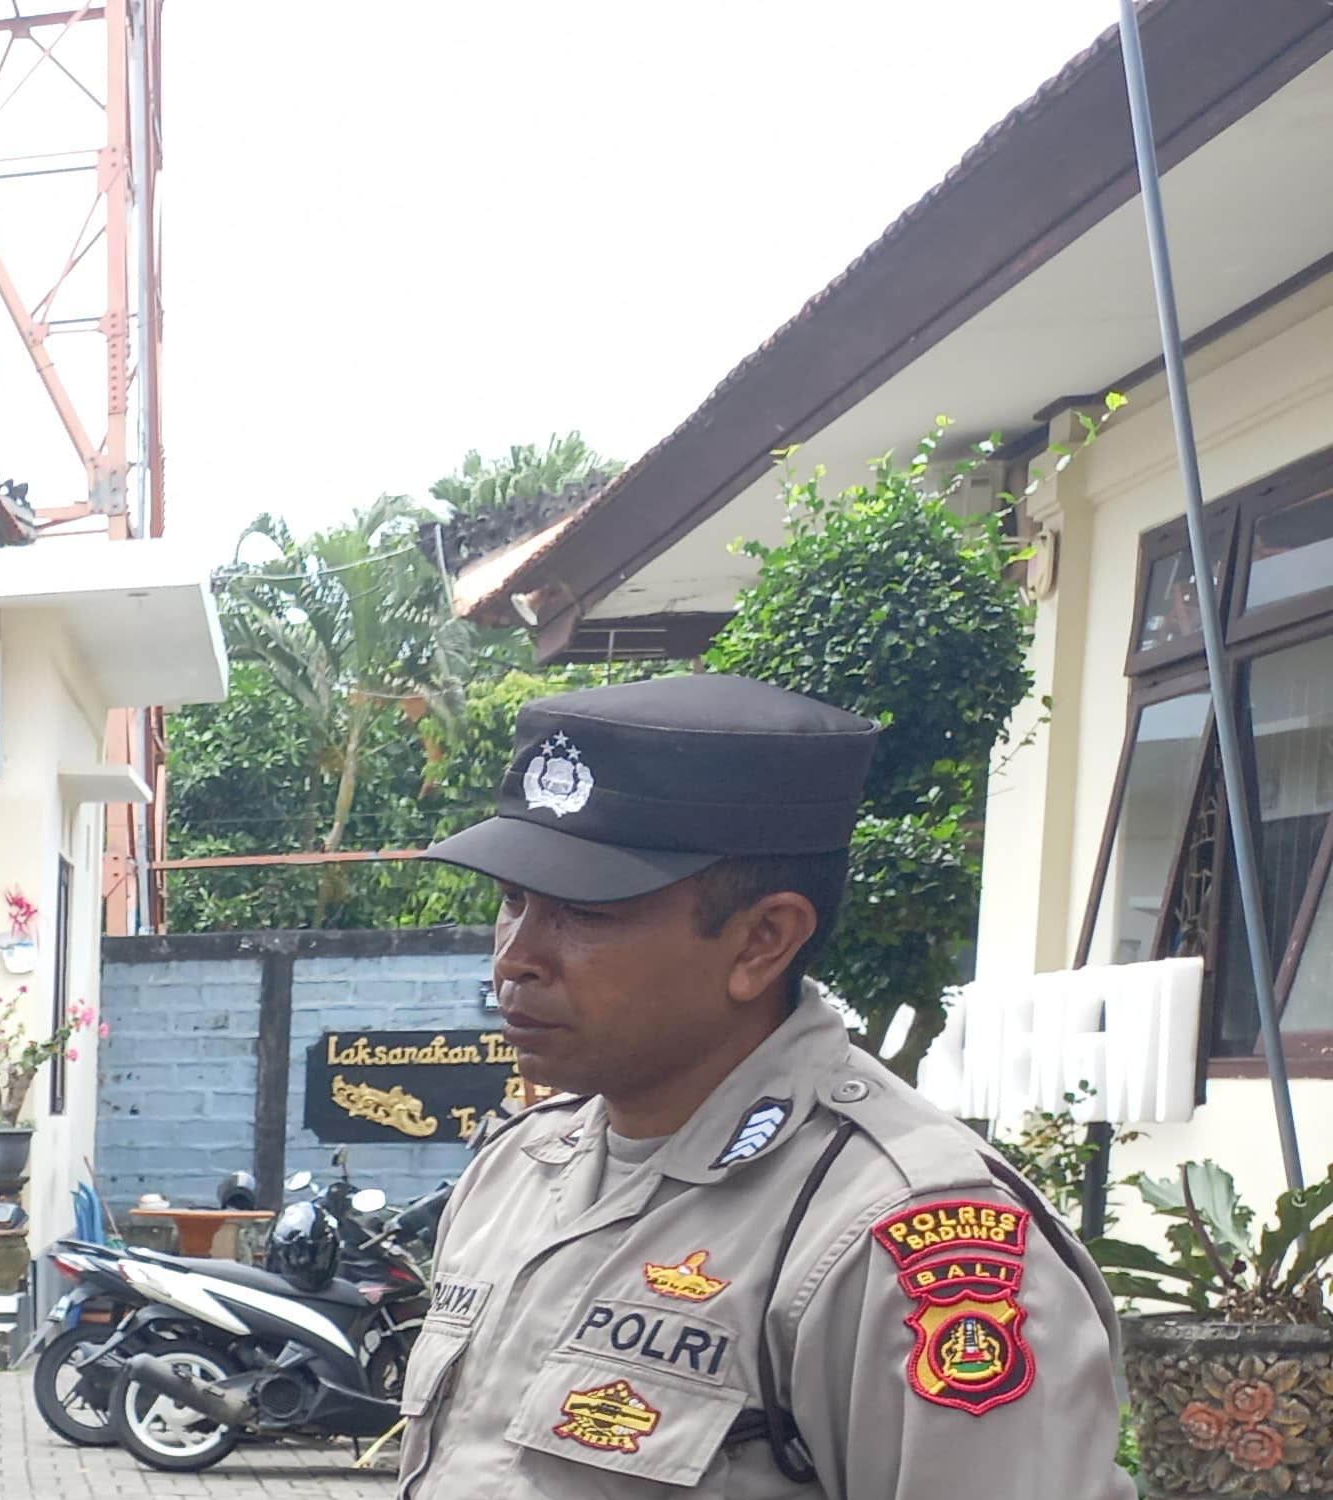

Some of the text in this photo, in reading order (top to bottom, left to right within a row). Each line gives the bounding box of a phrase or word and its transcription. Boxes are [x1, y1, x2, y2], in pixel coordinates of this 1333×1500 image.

[327, 1034, 483, 1067] Laksanakan
[888, 1206, 1016, 1242] POLRES
[907, 1227, 1006, 1250] BADUNG
[916, 1263, 1006, 1286] BALI
[576, 1305, 730, 1376] POLRI
